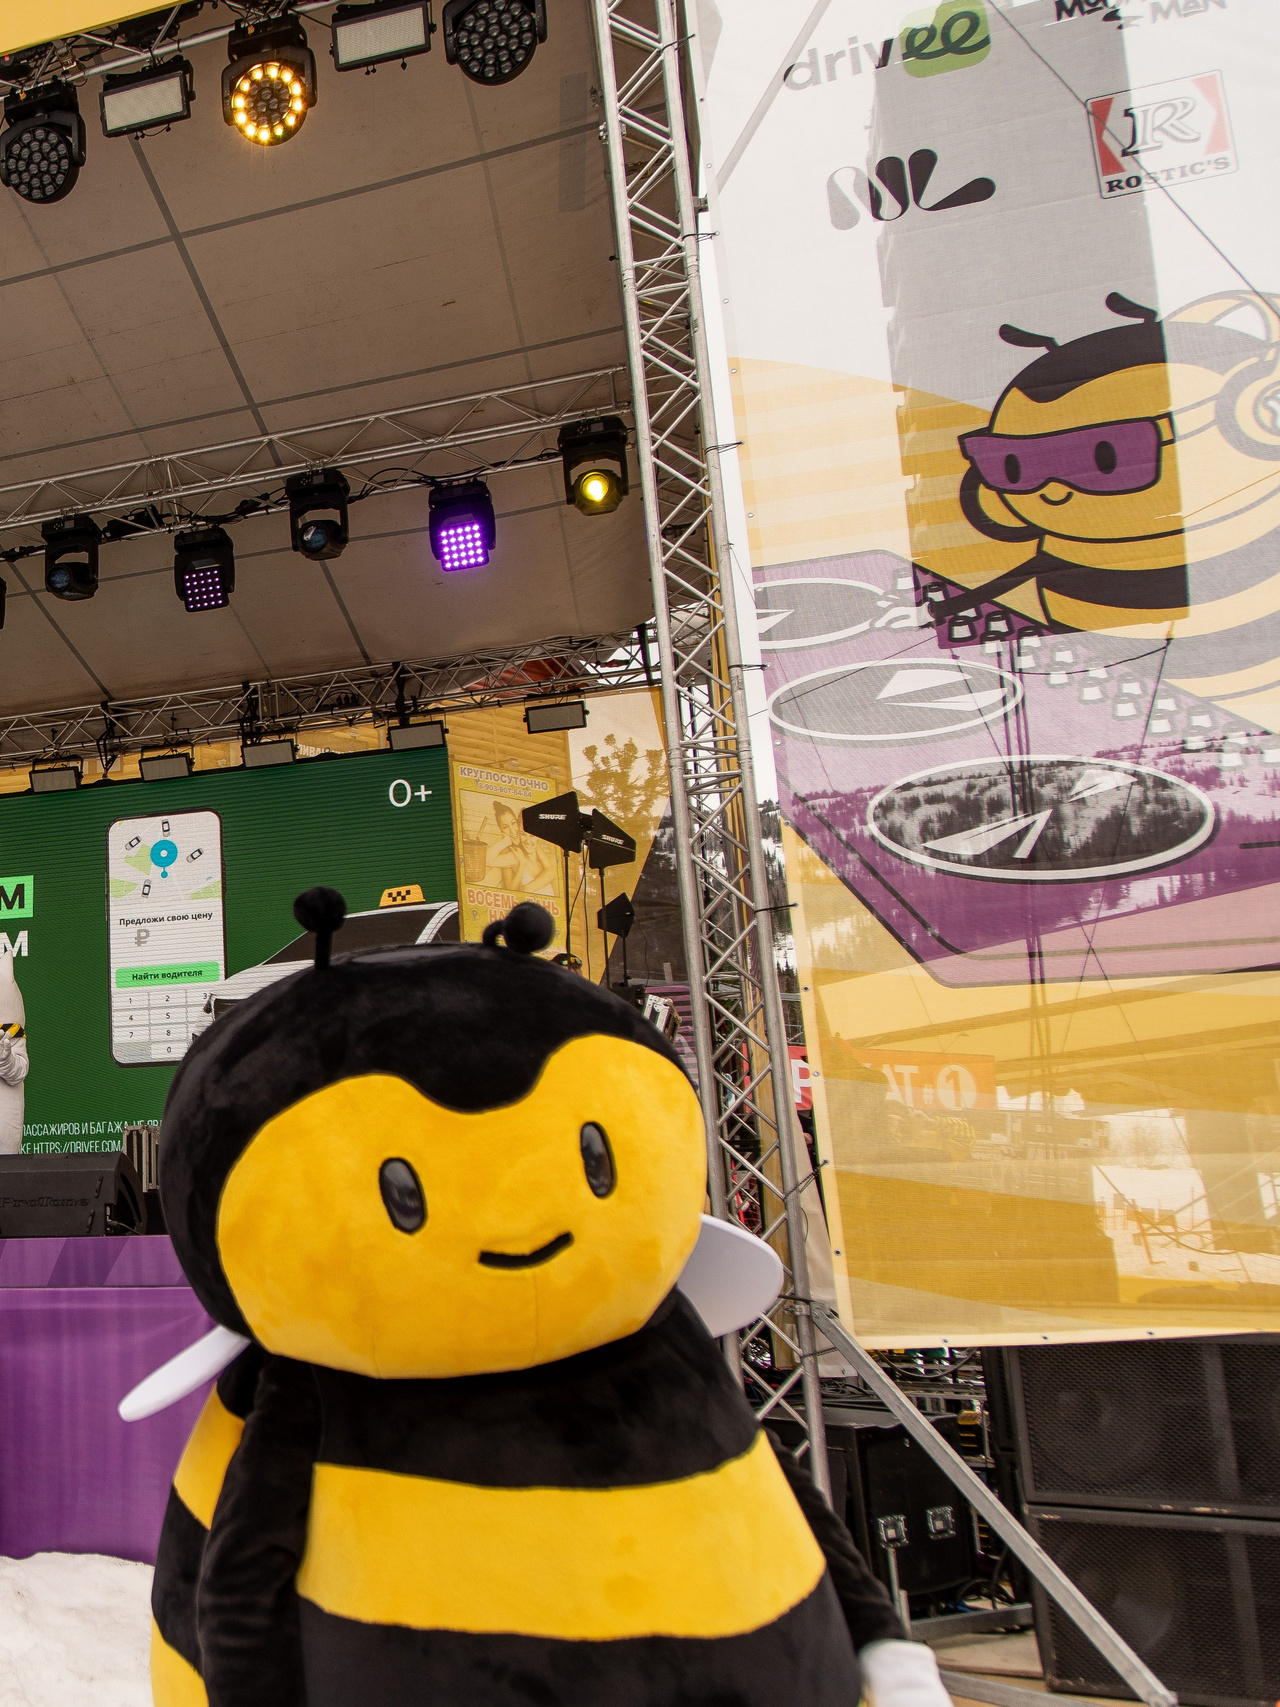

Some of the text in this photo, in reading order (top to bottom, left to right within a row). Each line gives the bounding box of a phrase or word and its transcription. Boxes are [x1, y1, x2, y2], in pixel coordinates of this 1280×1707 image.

[783, 11, 992, 91] drivee
[1106, 157, 1230, 193] ROSTIC'S
[459, 766, 549, 791] КРУГЛОСУТОЧНО
[388, 779, 432, 807] 0+
[601, 834, 624, 845] SHURE
[467, 888, 560, 917] ВОСЕМЬ НЬ
[119, 912, 213, 927] Предложи свою цену
[132, 970, 203, 981] Найти водителя
[81, 1122, 88, 1135] И
